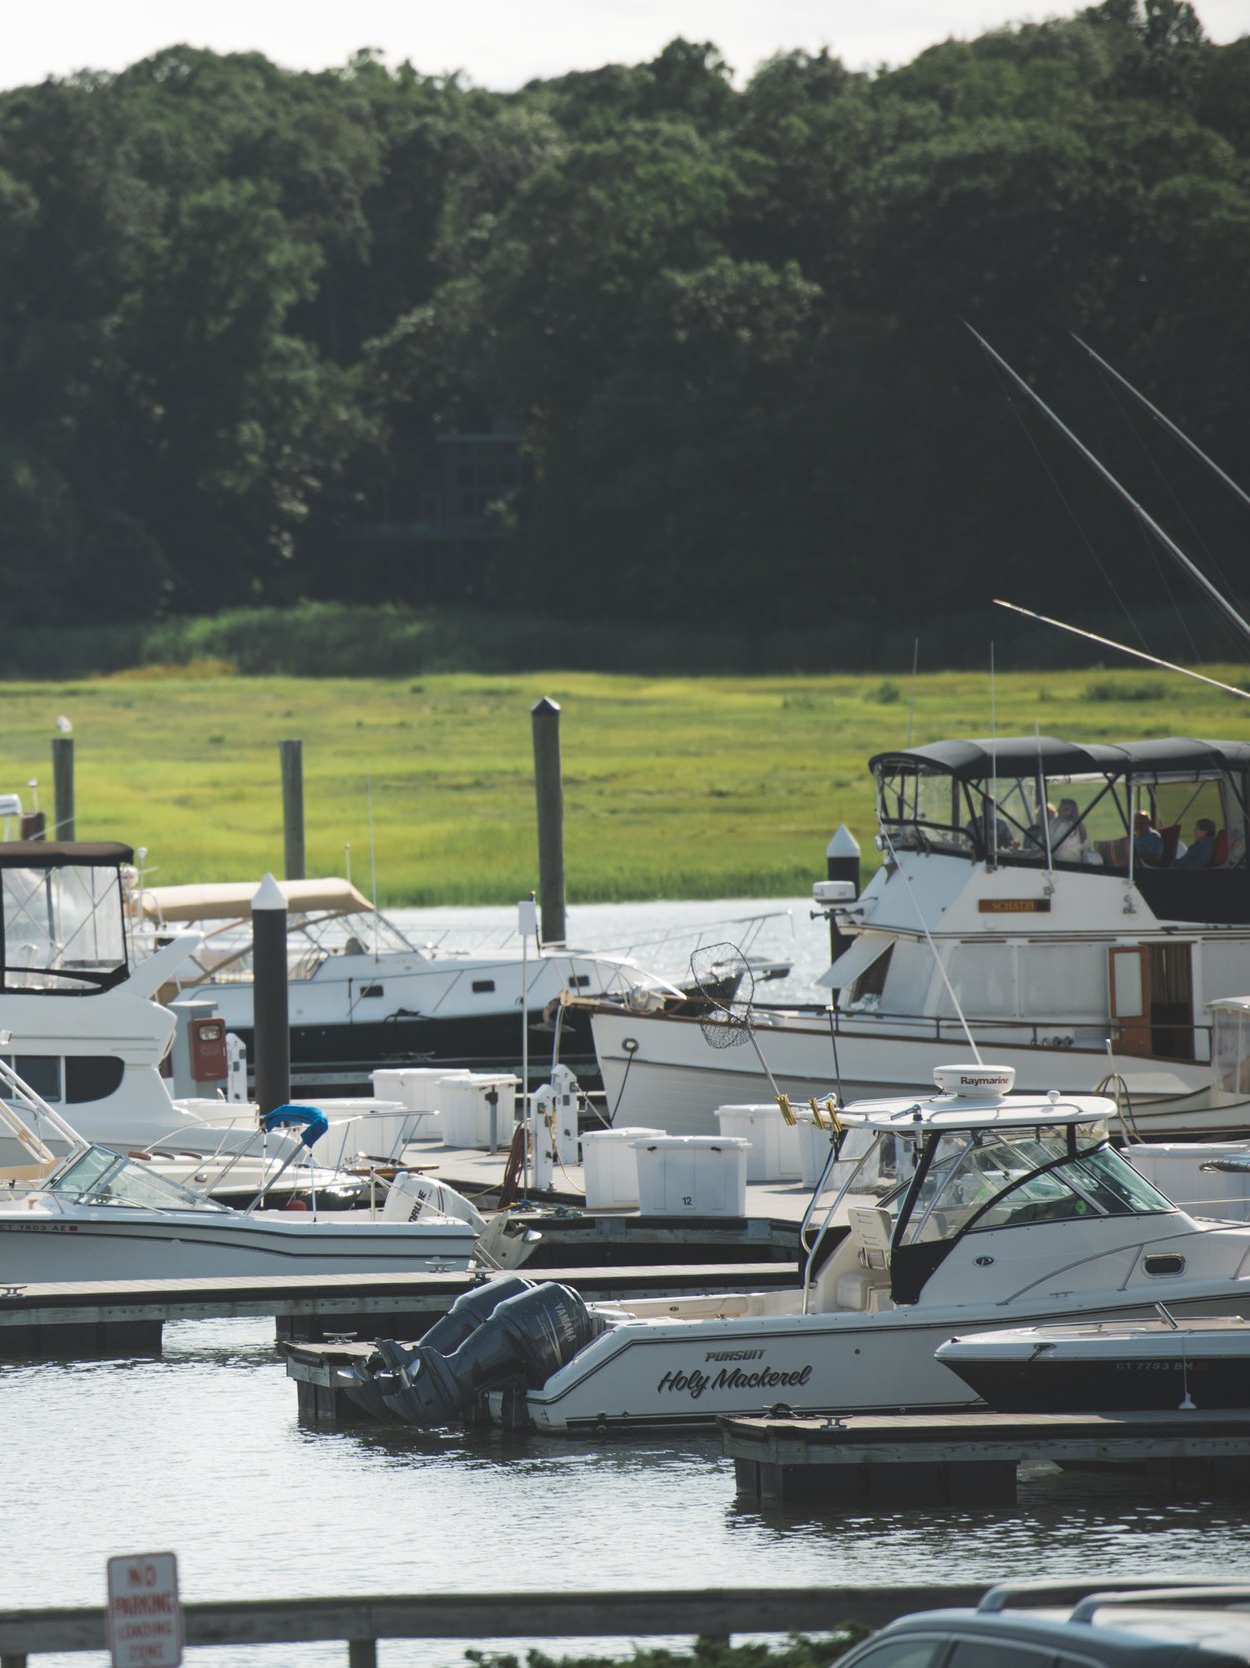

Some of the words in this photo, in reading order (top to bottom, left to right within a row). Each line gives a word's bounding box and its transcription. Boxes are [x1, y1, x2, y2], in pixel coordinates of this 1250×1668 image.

[960, 1076, 1009, 1086] Raymarine
[682, 1196, 693, 1206] 12
[555, 1302, 577, 1343] YAMAHA
[705, 1349, 767, 1362] PURSUIT
[1116, 1362, 1131, 1370] CT
[657, 1369, 711, 1399] Holy
[711, 1365, 813, 1390] Mackerel
[127, 1564, 156, 1588] NO
[114, 1592, 173, 1615] PARKING
